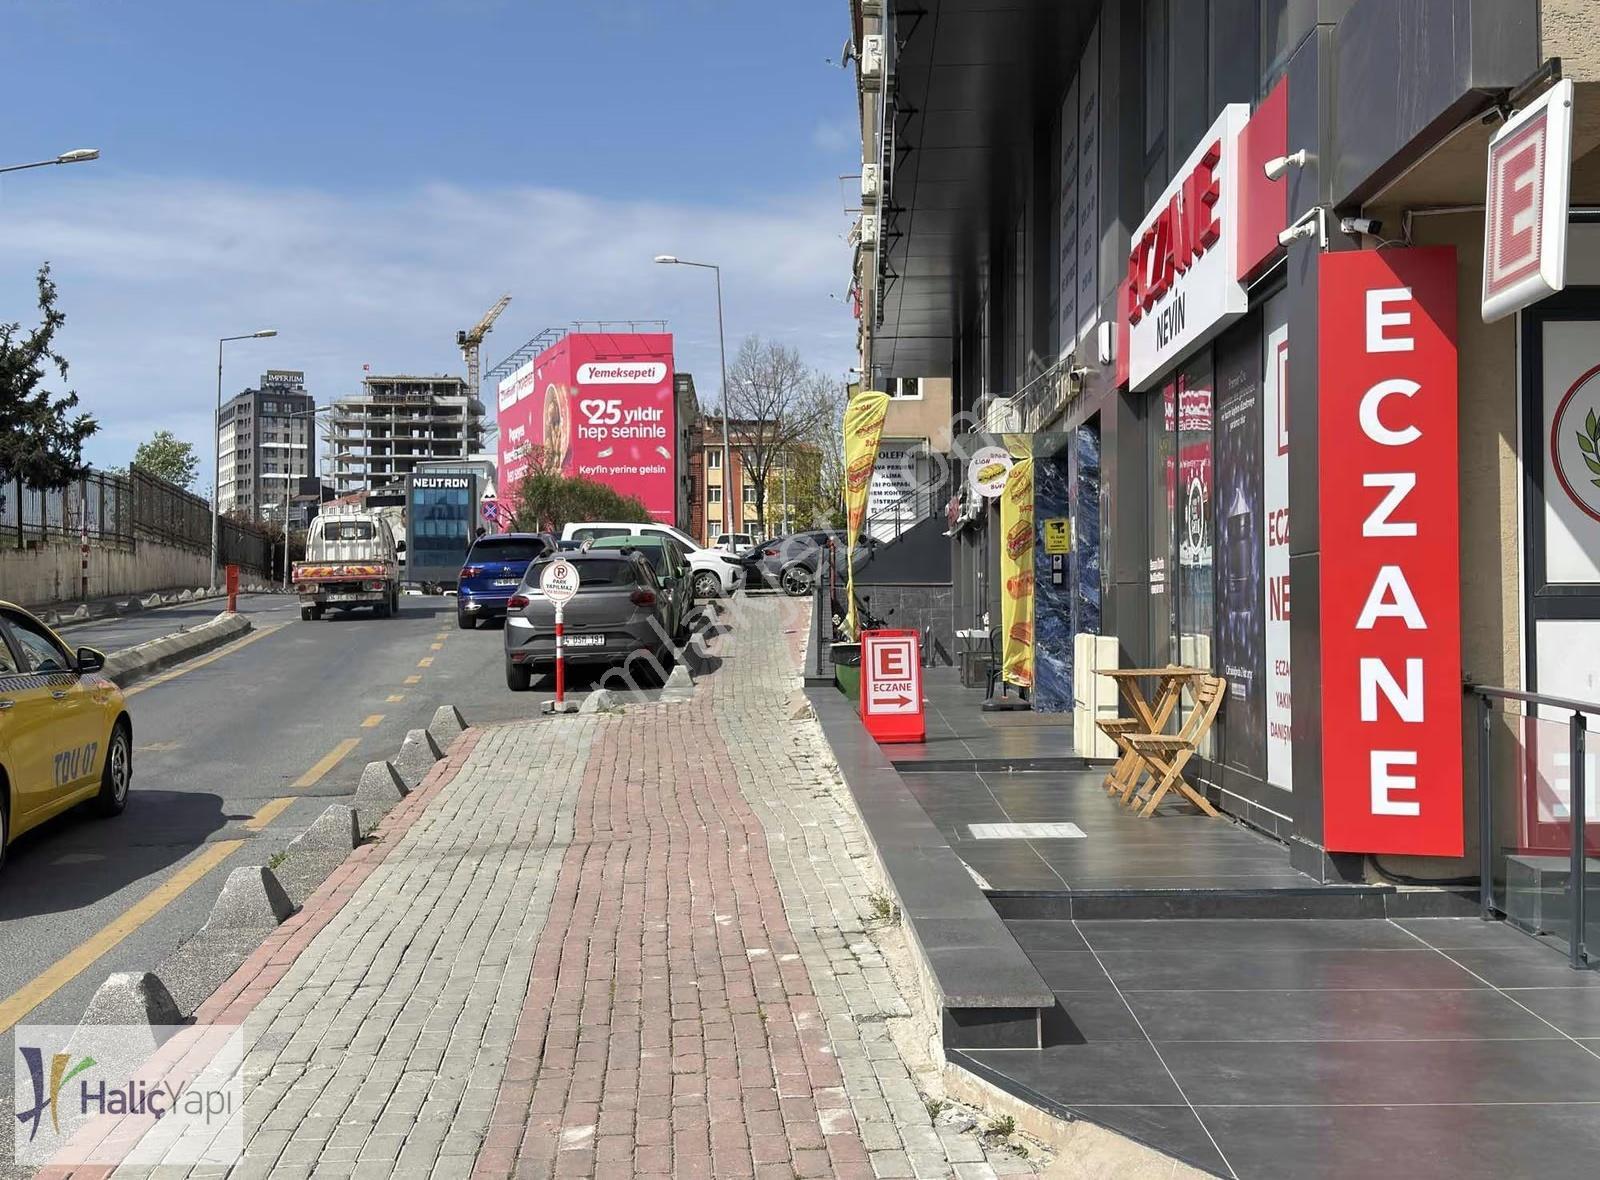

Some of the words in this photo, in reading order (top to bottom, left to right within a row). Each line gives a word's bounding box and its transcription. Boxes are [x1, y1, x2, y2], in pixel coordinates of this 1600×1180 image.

[1156, 290, 1186, 352] NEVİN
[588, 367, 656, 380] Yemeksepeti
[580, 399, 622, 425] 25
[624, 407, 664, 425] yıldır
[578, 424, 608, 442] hep
[611, 424, 667, 439] seninle
[579, 465, 607, 476] Keyfin
[609, 466, 638, 476] yerine
[639, 464, 667, 476] gelsin
[412, 478, 469, 488] NEUTRON
[1355, 286, 1428, 817] ECZANE
[880, 648, 903, 675] E
[873, 683, 912, 692] ECZANE
